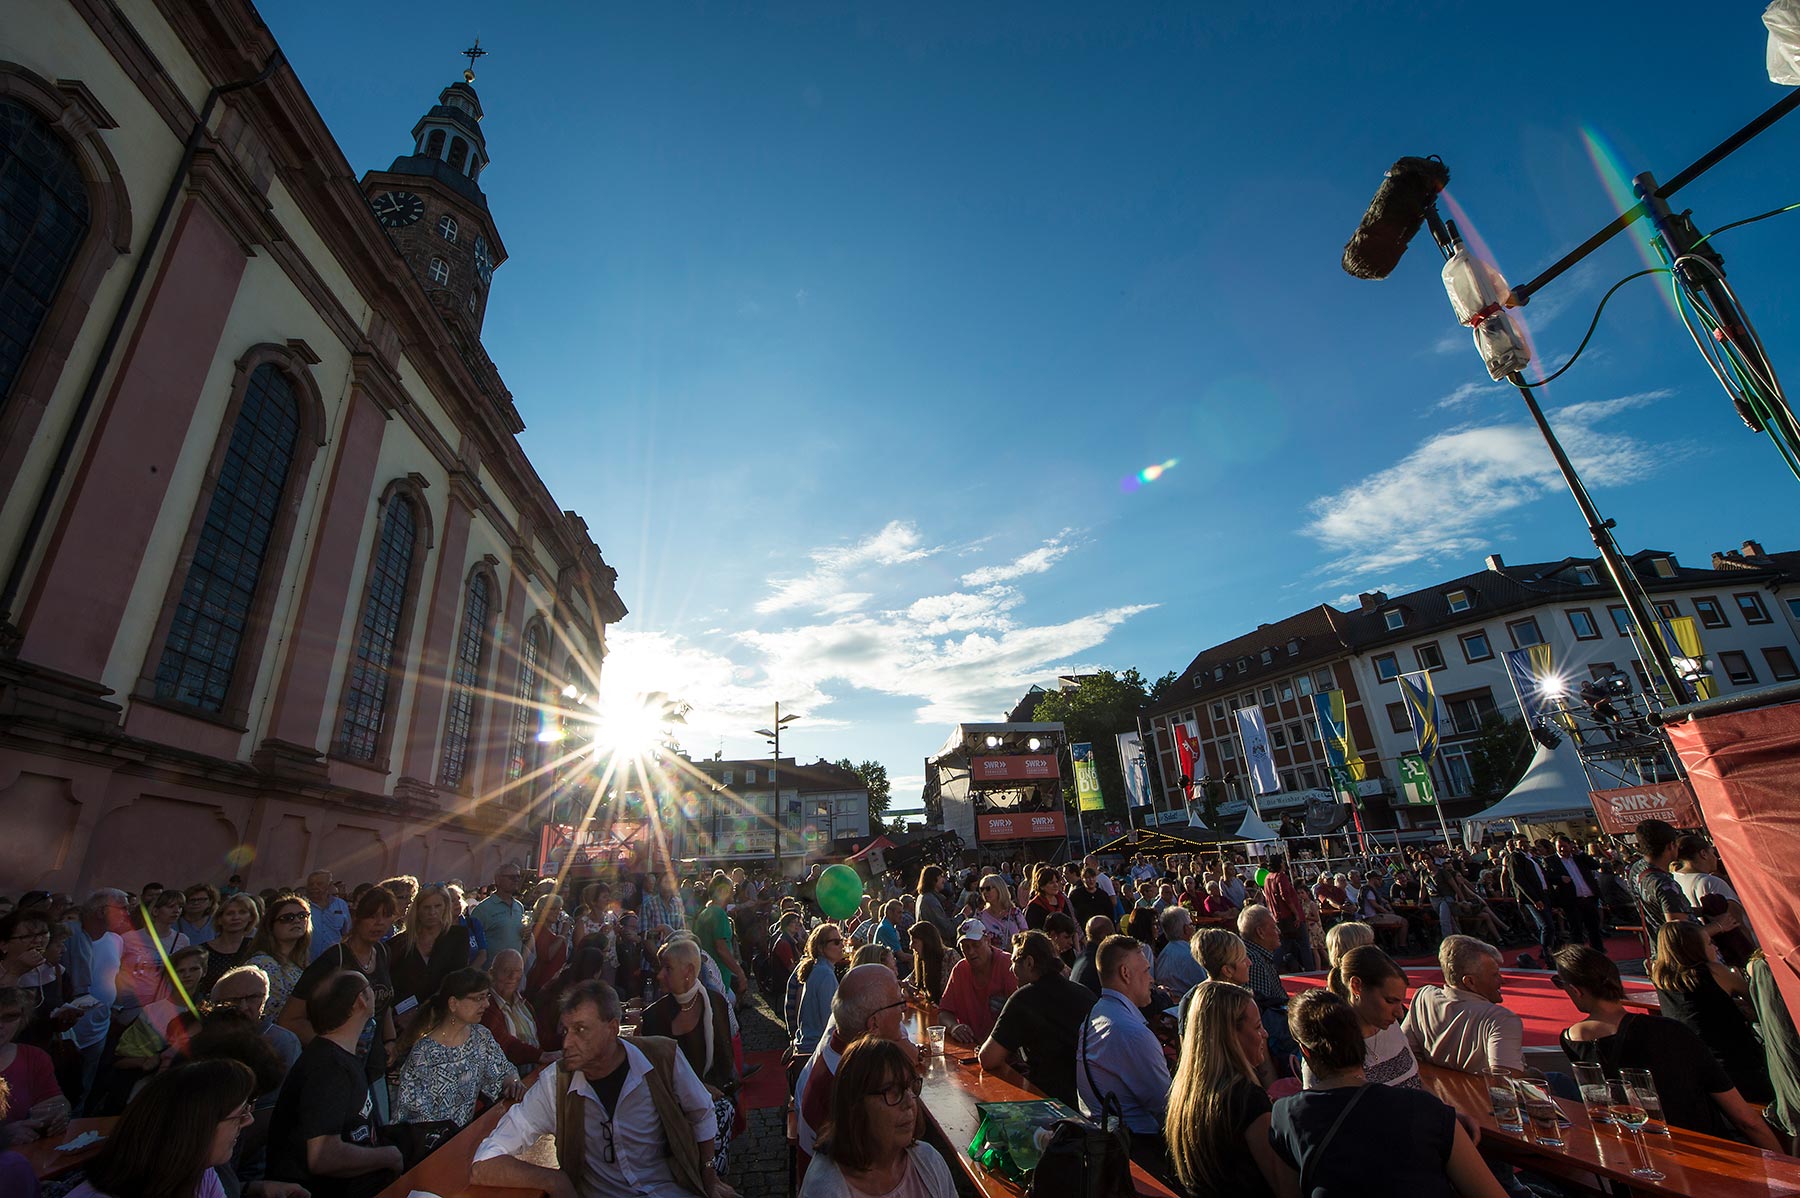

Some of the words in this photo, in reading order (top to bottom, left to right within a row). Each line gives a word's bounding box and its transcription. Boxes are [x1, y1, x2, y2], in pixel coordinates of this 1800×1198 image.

[983, 760, 999, 769] SWR
[1025, 760, 1041, 768] SWR
[1610, 793, 1651, 812] SWR
[988, 819, 1005, 828] SWR
[1031, 817, 1047, 826] SWR
[1619, 810, 1676, 823] FERNSEHEN
